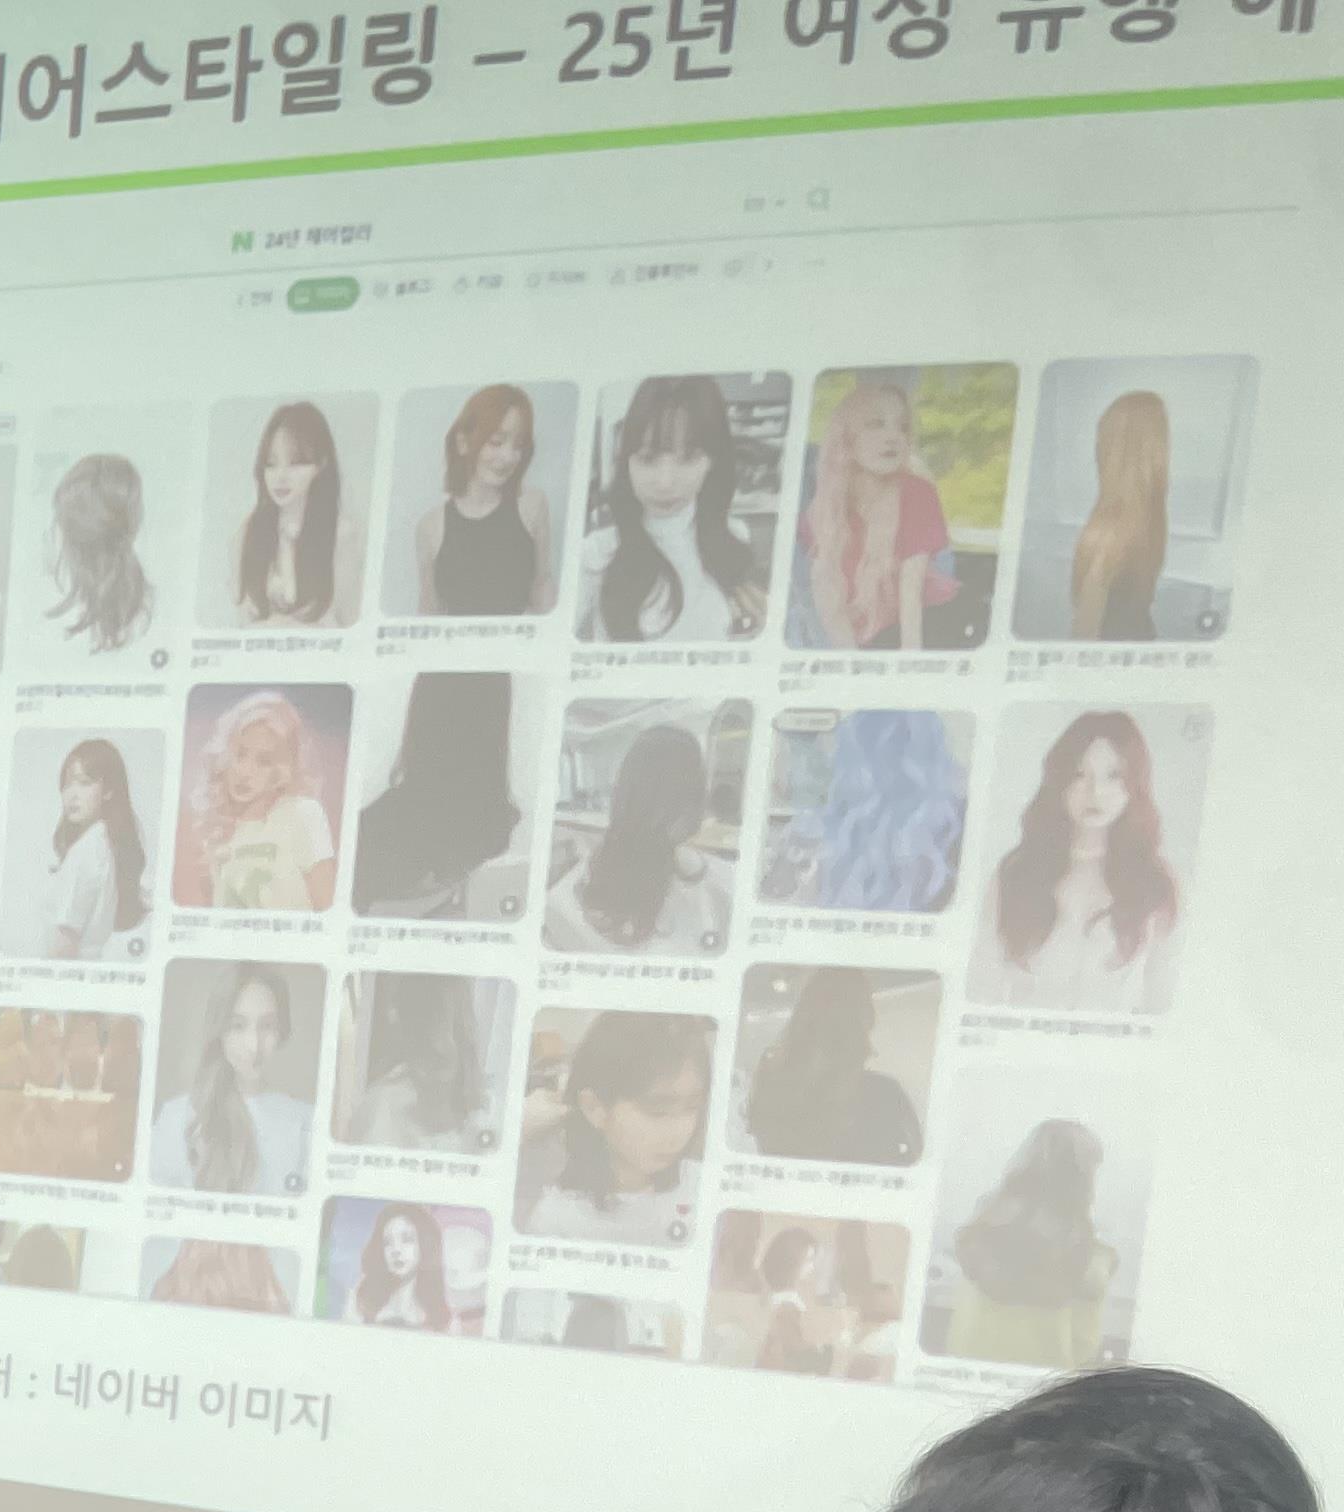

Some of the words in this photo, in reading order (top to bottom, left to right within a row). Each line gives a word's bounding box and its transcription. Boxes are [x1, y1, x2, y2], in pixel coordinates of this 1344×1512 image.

[557, 0, 738, 83] 25년
[53, 1362, 180, 1422] 네이버
[198, 1381, 333, 1442] 이미지
